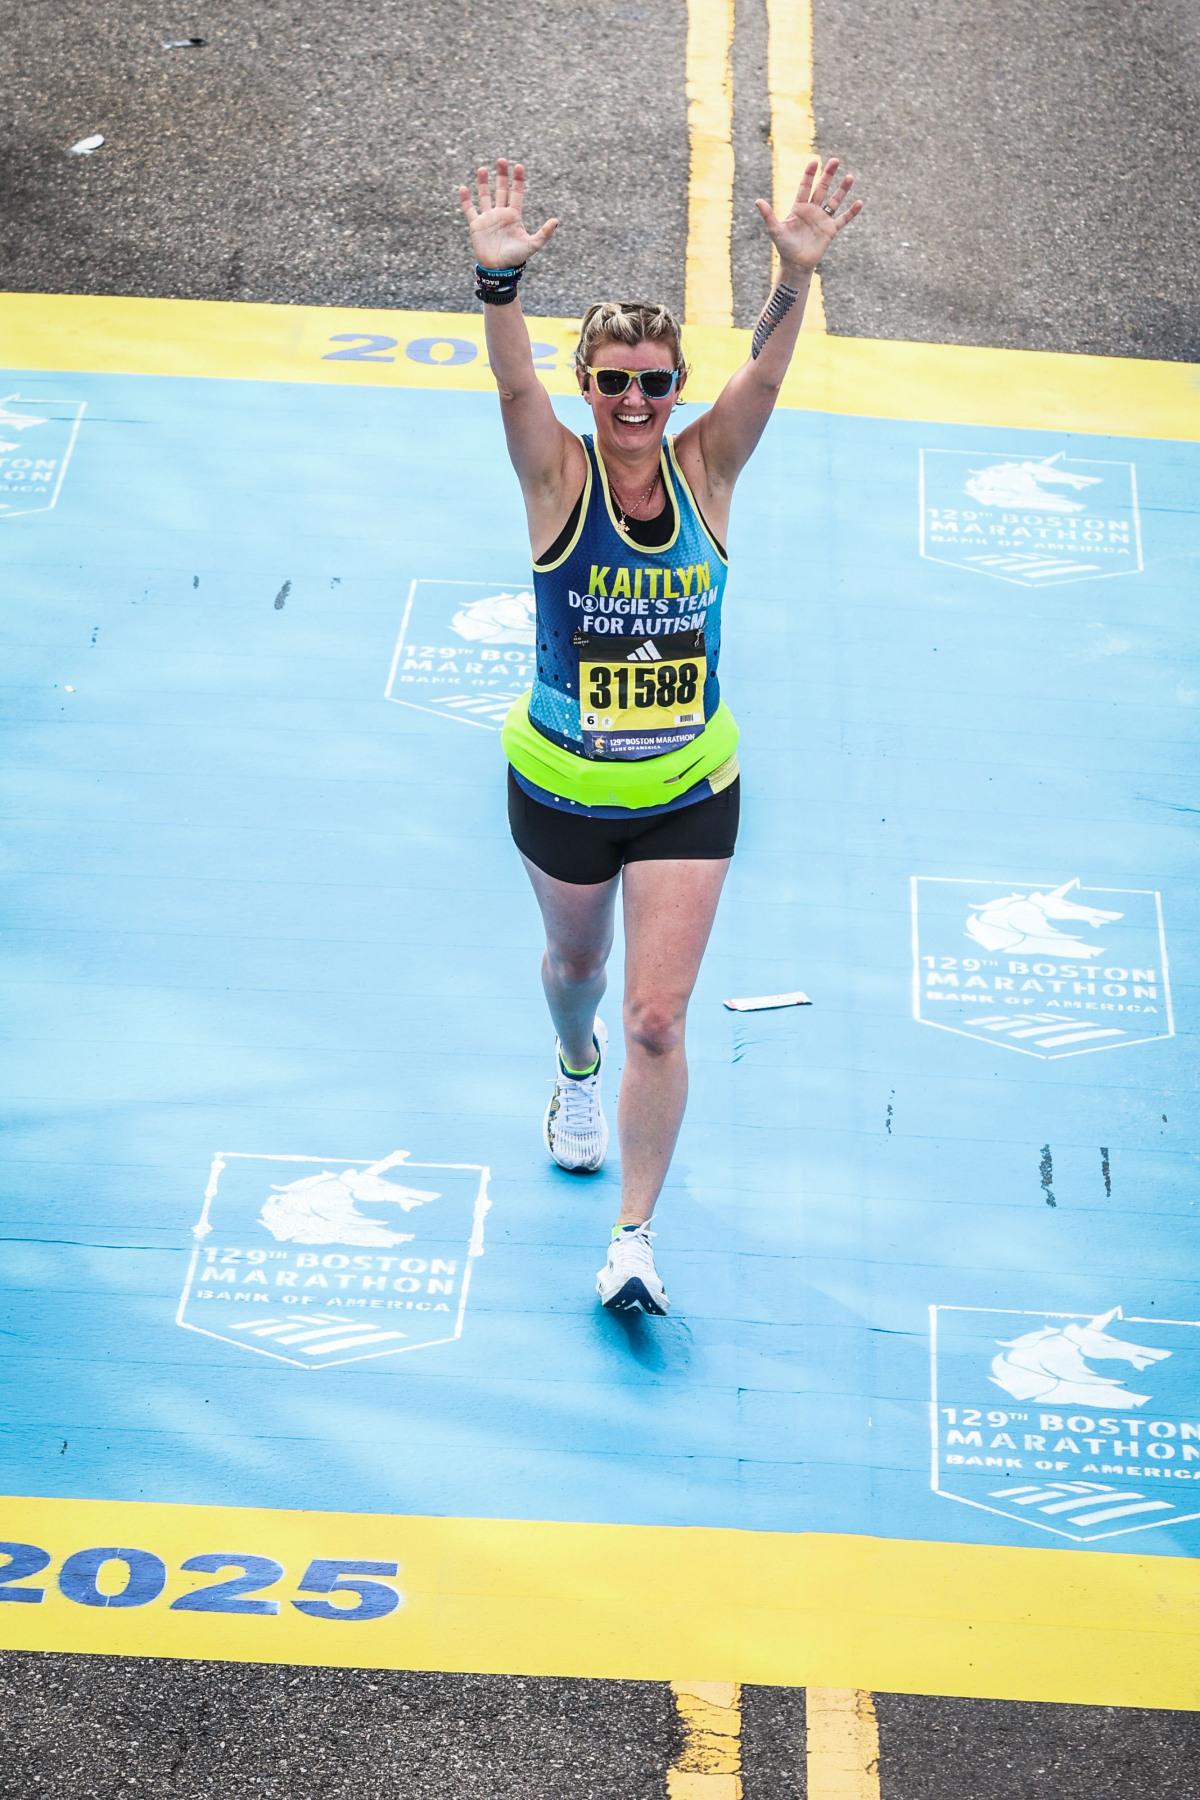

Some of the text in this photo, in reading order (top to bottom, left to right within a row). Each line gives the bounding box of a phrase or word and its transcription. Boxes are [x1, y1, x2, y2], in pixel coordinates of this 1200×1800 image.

[481, 277, 500, 286] BACK
[321, 333, 577, 370] 20
[930, 520, 1130, 544] MARATHON
[1001, 513, 1130, 532] BOSTON
[930, 535, 1131, 555] BANK OF AMERICA
[588, 560, 711, 599] KAITLYN
[568, 585, 719, 615] DOUGIE'S TEAM
[583, 610, 707, 635] FOR AUTISM
[480, 648, 537, 662] BOS
[400, 675, 461, 685] BANK
[402, 659, 533, 677] MARAT
[589, 662, 699, 709] 31588
[586, 715, 595, 725] 6
[625, 737, 655, 746] BOSTON
[656, 733, 696, 744] MARATHON
[1008, 960, 1156, 983] BOSTON
[926, 972, 1158, 1000] MARATHON
[926, 991, 1159, 1014] BANK OF AMERICA
[296, 1252, 457, 1276] BOSTON
[200, 1266, 454, 1295] MARATHON
[197, 1289, 451, 1313] BANK OF AMERICA
[941, 1407, 1200, 1441] 129TH BOSTON
[947, 1429, 1200, 1462] MARATHON
[946, 1453, 1024, 1469] BANK
[1034, 1460, 1071, 1472] OF
